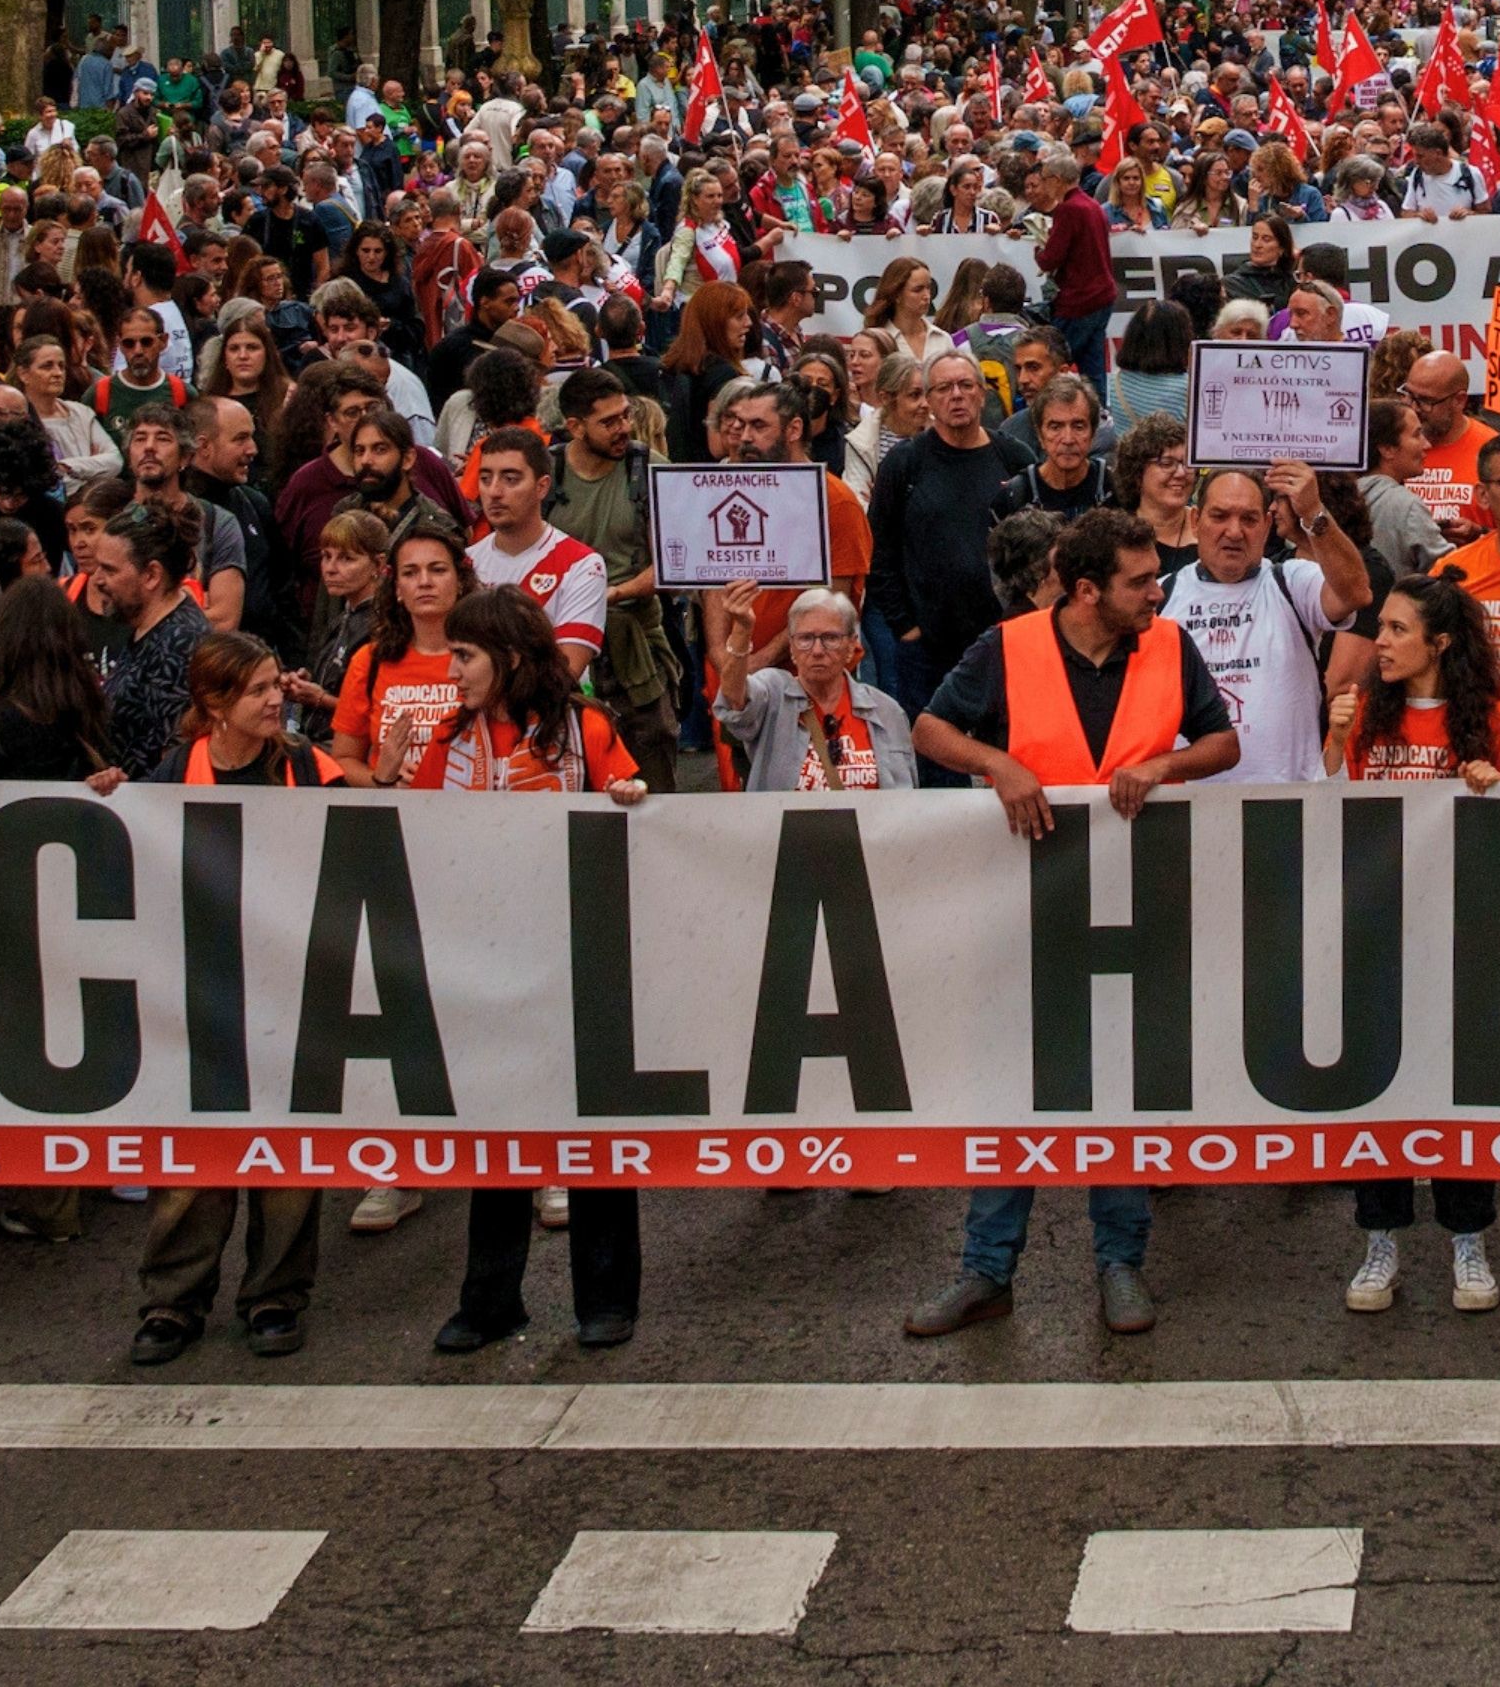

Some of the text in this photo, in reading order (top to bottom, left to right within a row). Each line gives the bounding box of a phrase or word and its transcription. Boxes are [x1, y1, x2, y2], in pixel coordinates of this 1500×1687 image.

[1237, 353, 1331, 370] LA emvs
[1233, 375, 1331, 387] REGALÓ NUESTRA
[1262, 390, 1301, 409] VIDA
[1222, 432, 1338, 444] Y NUESTRA DIGNIDAD
[692, 474, 780, 488] CARABANCHEL
[707, 550, 776, 562] RESISTE !!
[1190, 605, 1202, 615] LA
[386, 684, 458, 702] SINDICATO
[567, 808, 912, 1116] LA
[44, 1134, 197, 1176] DEL
[236, 1135, 654, 1182] ALQUILER
[696, 1135, 855, 1176] 50%
